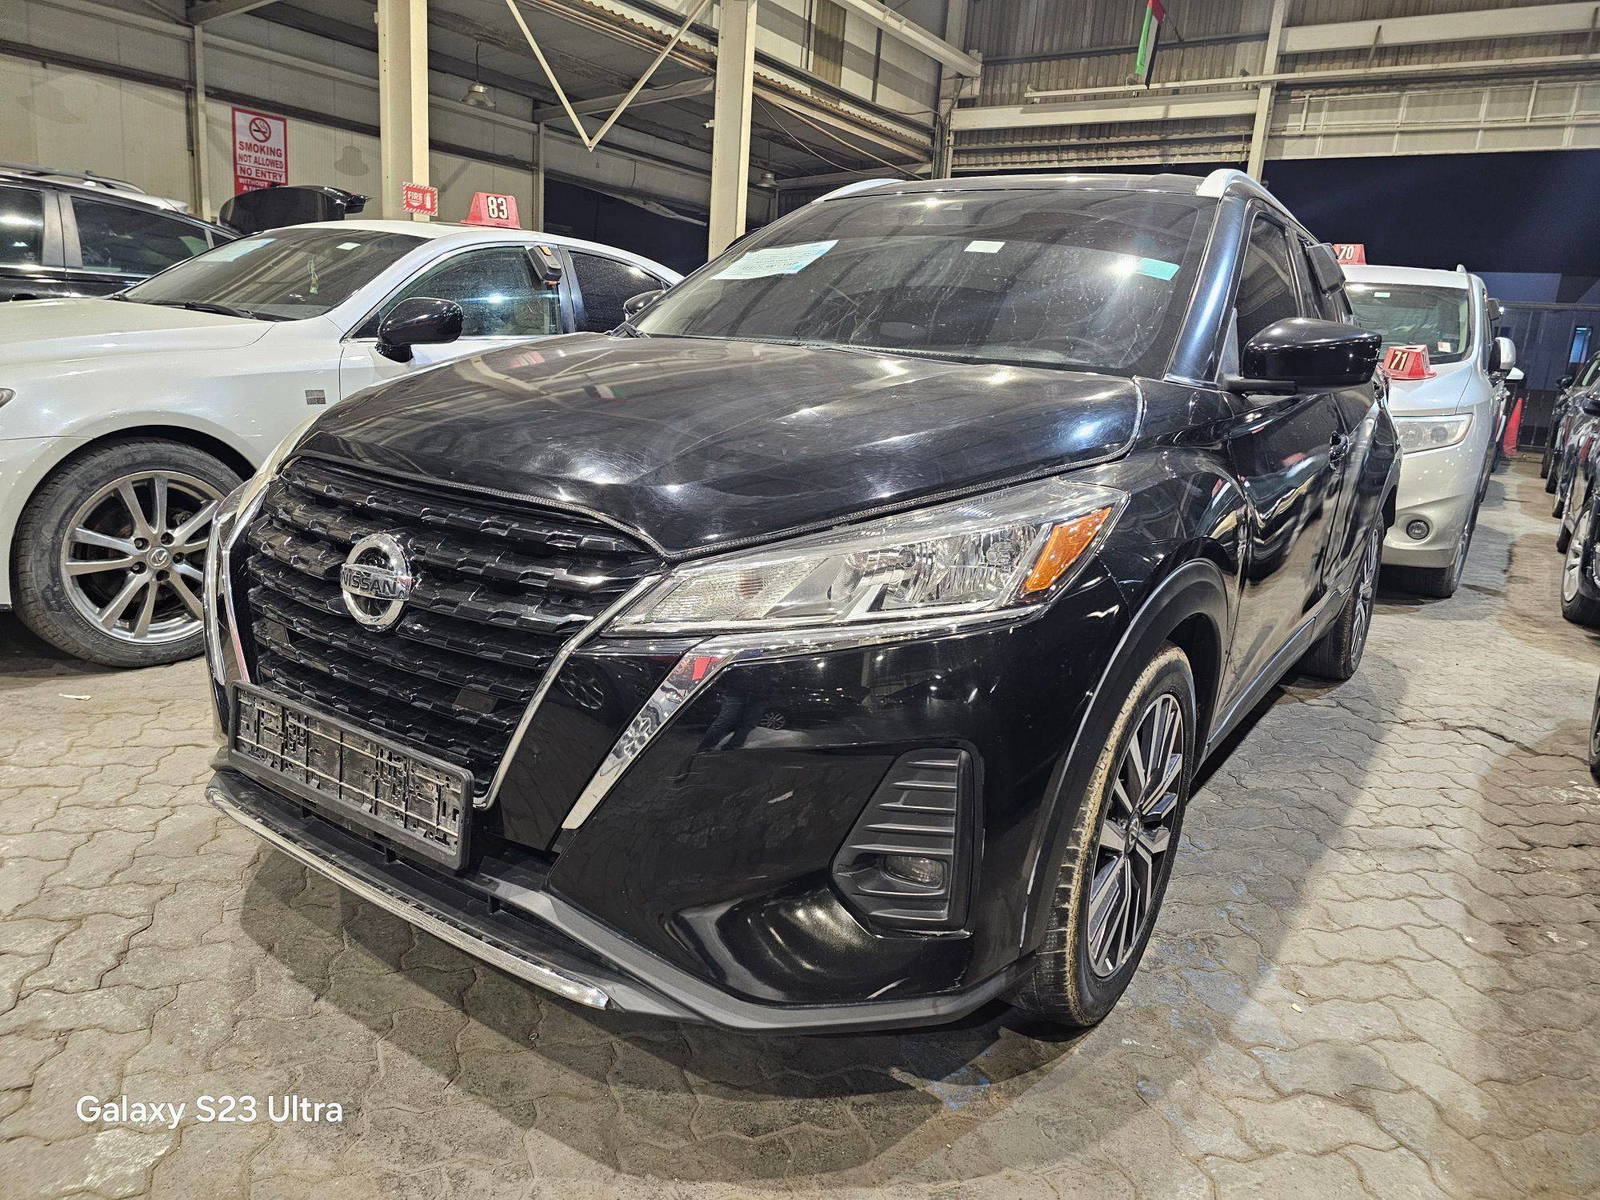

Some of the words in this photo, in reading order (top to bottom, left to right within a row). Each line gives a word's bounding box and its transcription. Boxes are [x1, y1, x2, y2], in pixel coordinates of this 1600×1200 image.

[239, 141, 282, 157] SMOKING
[238, 153, 252, 163] NOT
[254, 156, 284, 169] ALLOWED
[240, 166, 252, 176] NO
[255, 169, 283, 181] ENTRY
[407, 191, 423, 201] FIRE
[487, 196, 508, 219] 83
[1338, 245, 1355, 260] 70
[1390, 350, 1409, 371] 71
[344, 568, 397, 595] NISSAN
